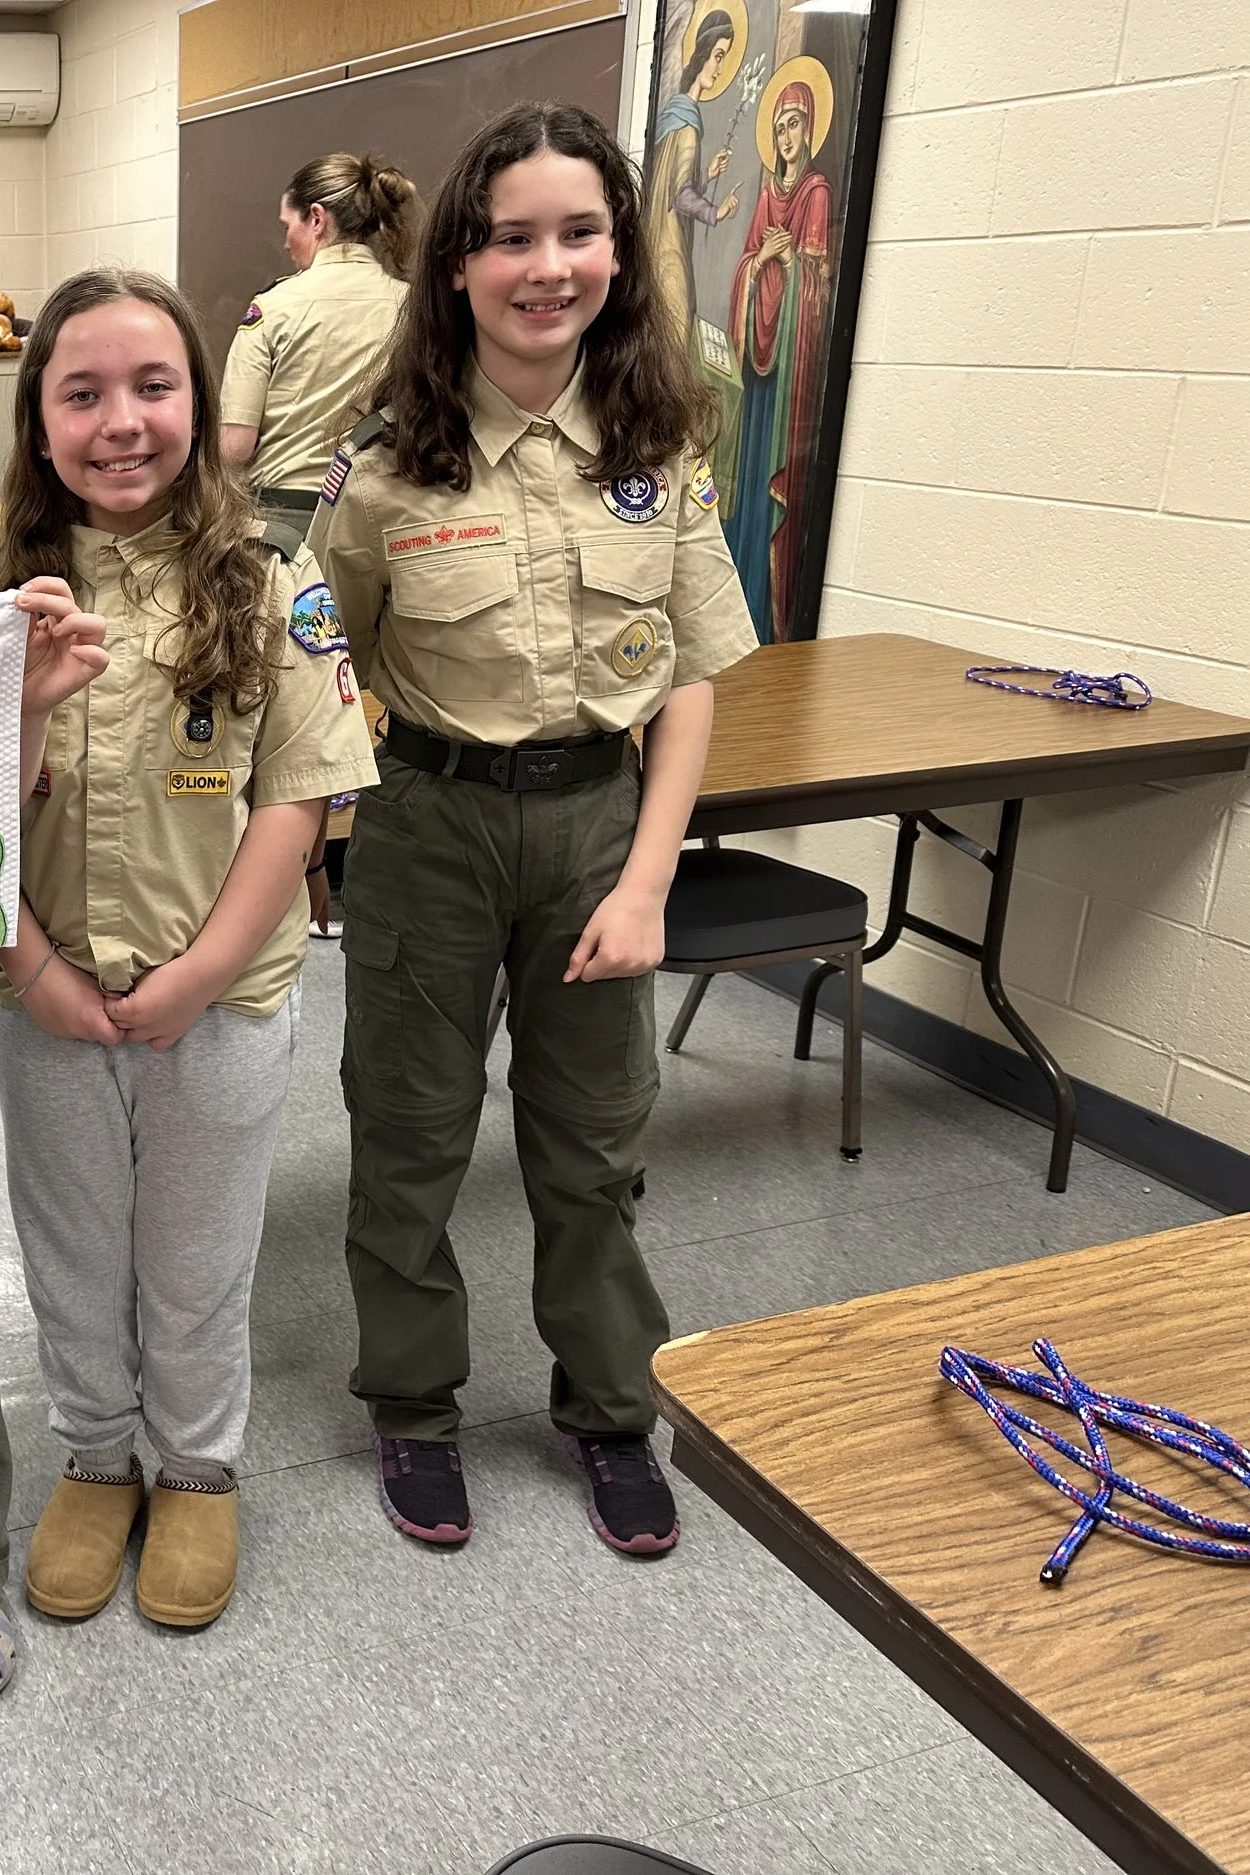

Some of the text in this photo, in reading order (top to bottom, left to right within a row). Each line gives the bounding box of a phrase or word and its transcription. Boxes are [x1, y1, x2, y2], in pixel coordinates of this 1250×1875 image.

[618, 508, 654, 520] SINCE 1910
[388, 525, 501, 553] SCOUTING AMERICA
[185, 776, 217, 789] LION
